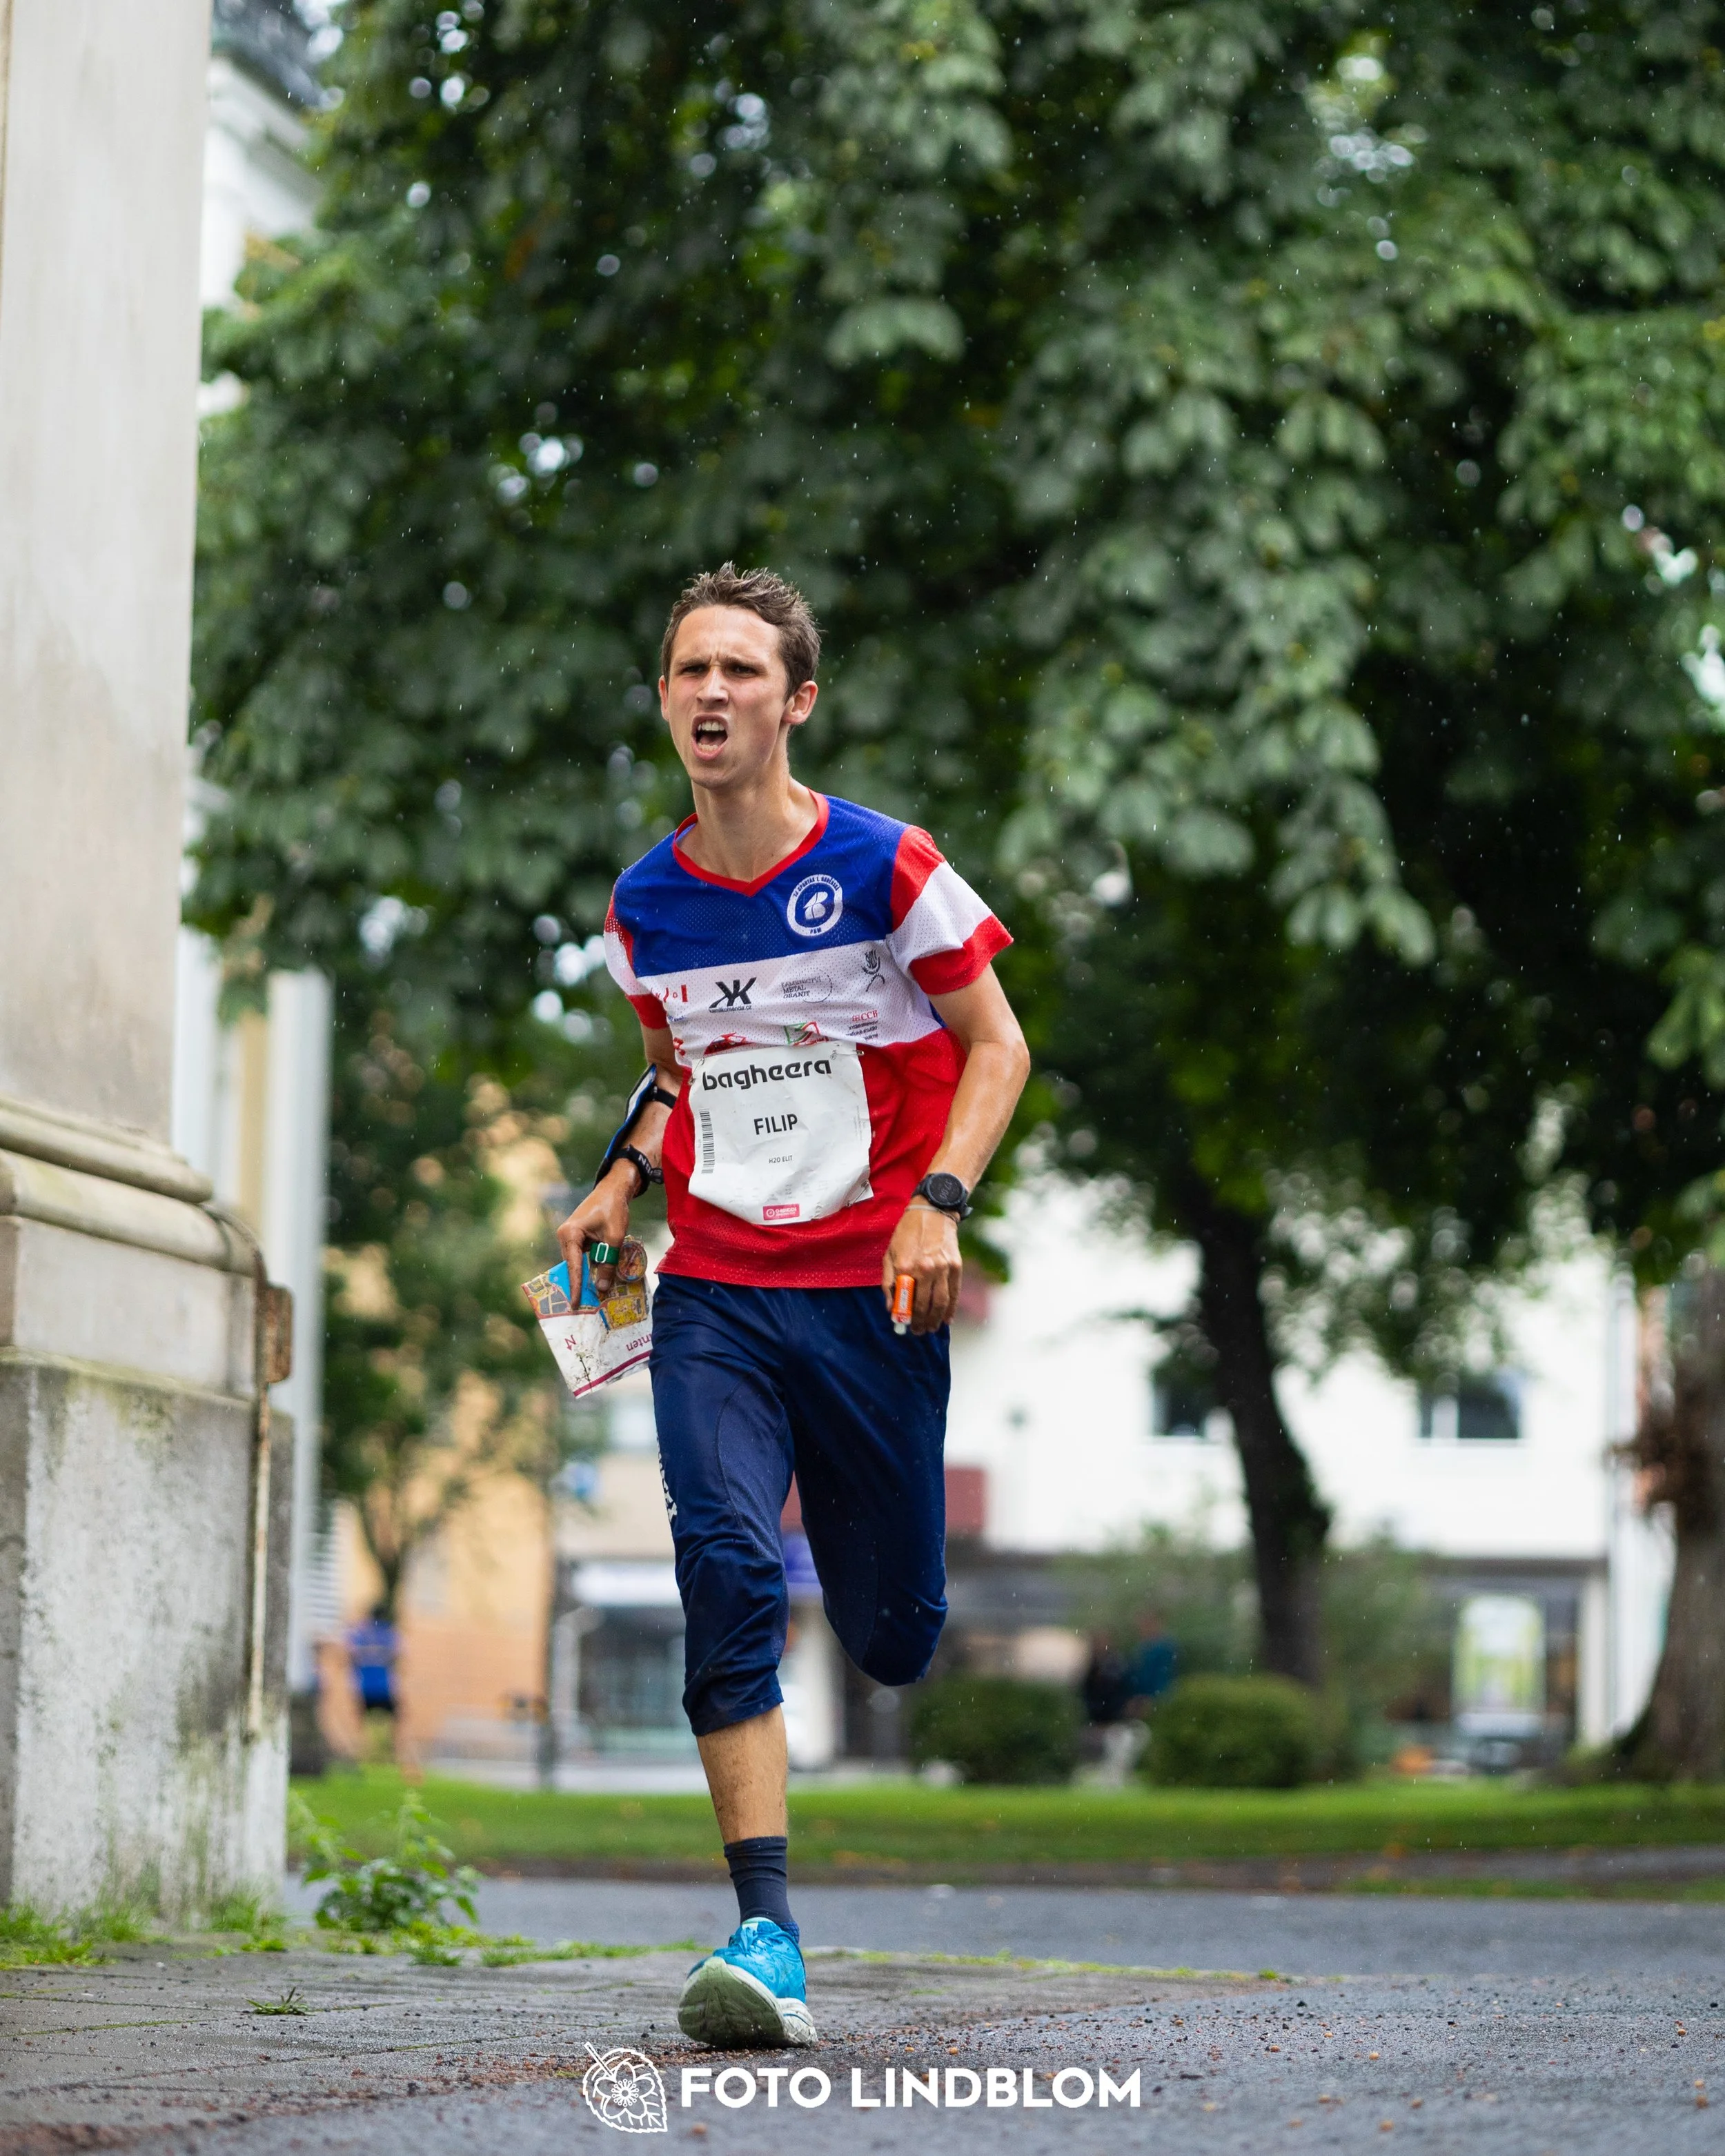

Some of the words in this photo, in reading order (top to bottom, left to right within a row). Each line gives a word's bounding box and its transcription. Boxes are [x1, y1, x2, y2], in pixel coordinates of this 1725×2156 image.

[798, 877, 816, 891] SPARTAK
[783, 985, 806, 994] METAL
[861, 1009, 878, 1020] CCB
[702, 1059, 831, 1091] bagheera
[753, 1114, 798, 1136] FILIP
